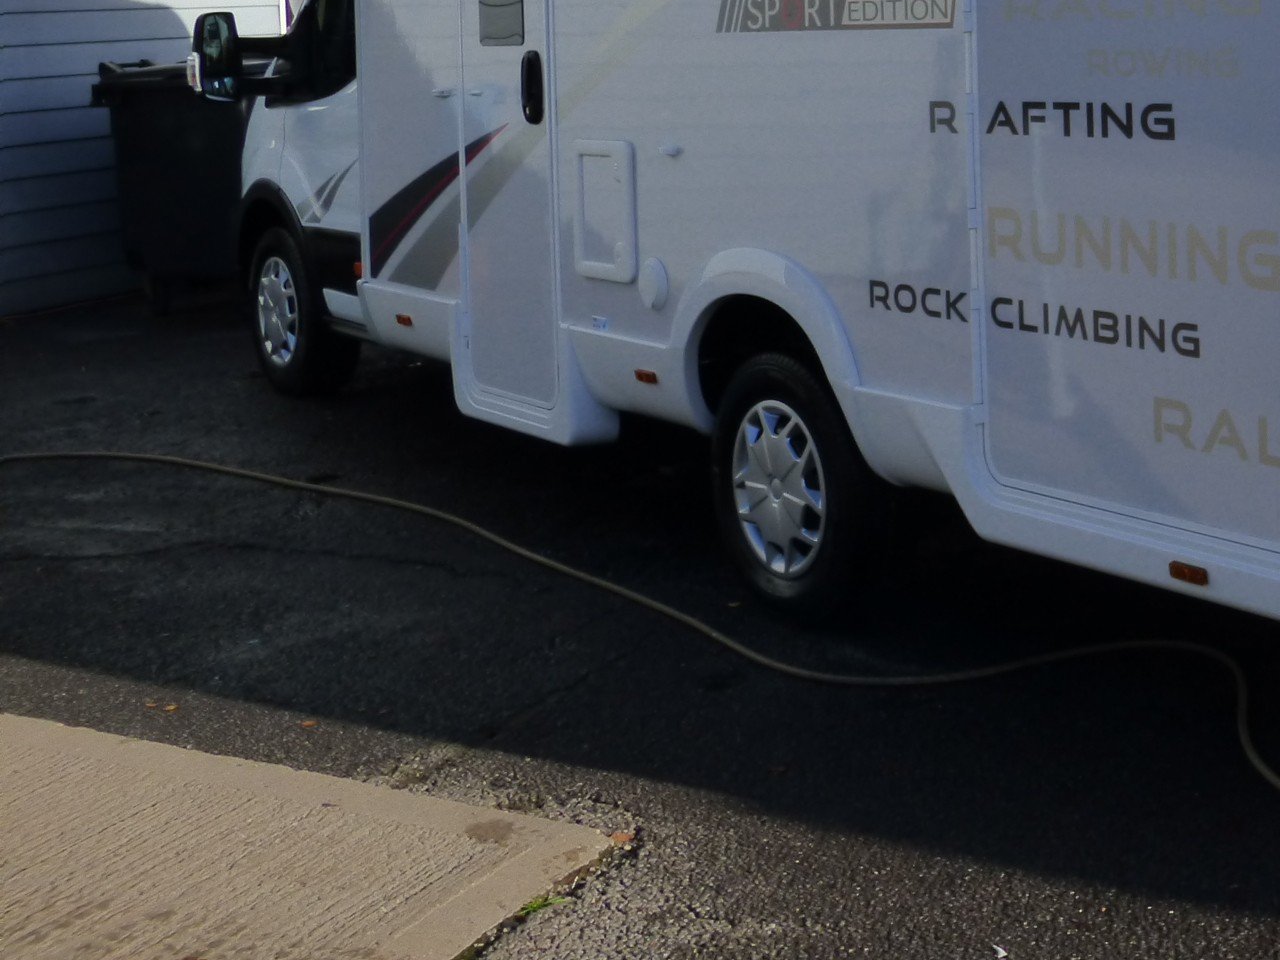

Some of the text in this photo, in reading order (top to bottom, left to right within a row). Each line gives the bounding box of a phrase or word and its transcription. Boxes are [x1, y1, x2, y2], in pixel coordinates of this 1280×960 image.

[1085, 47, 1241, 78] ROWING
[869, 280, 1201, 358] ROCK CLIMBING
